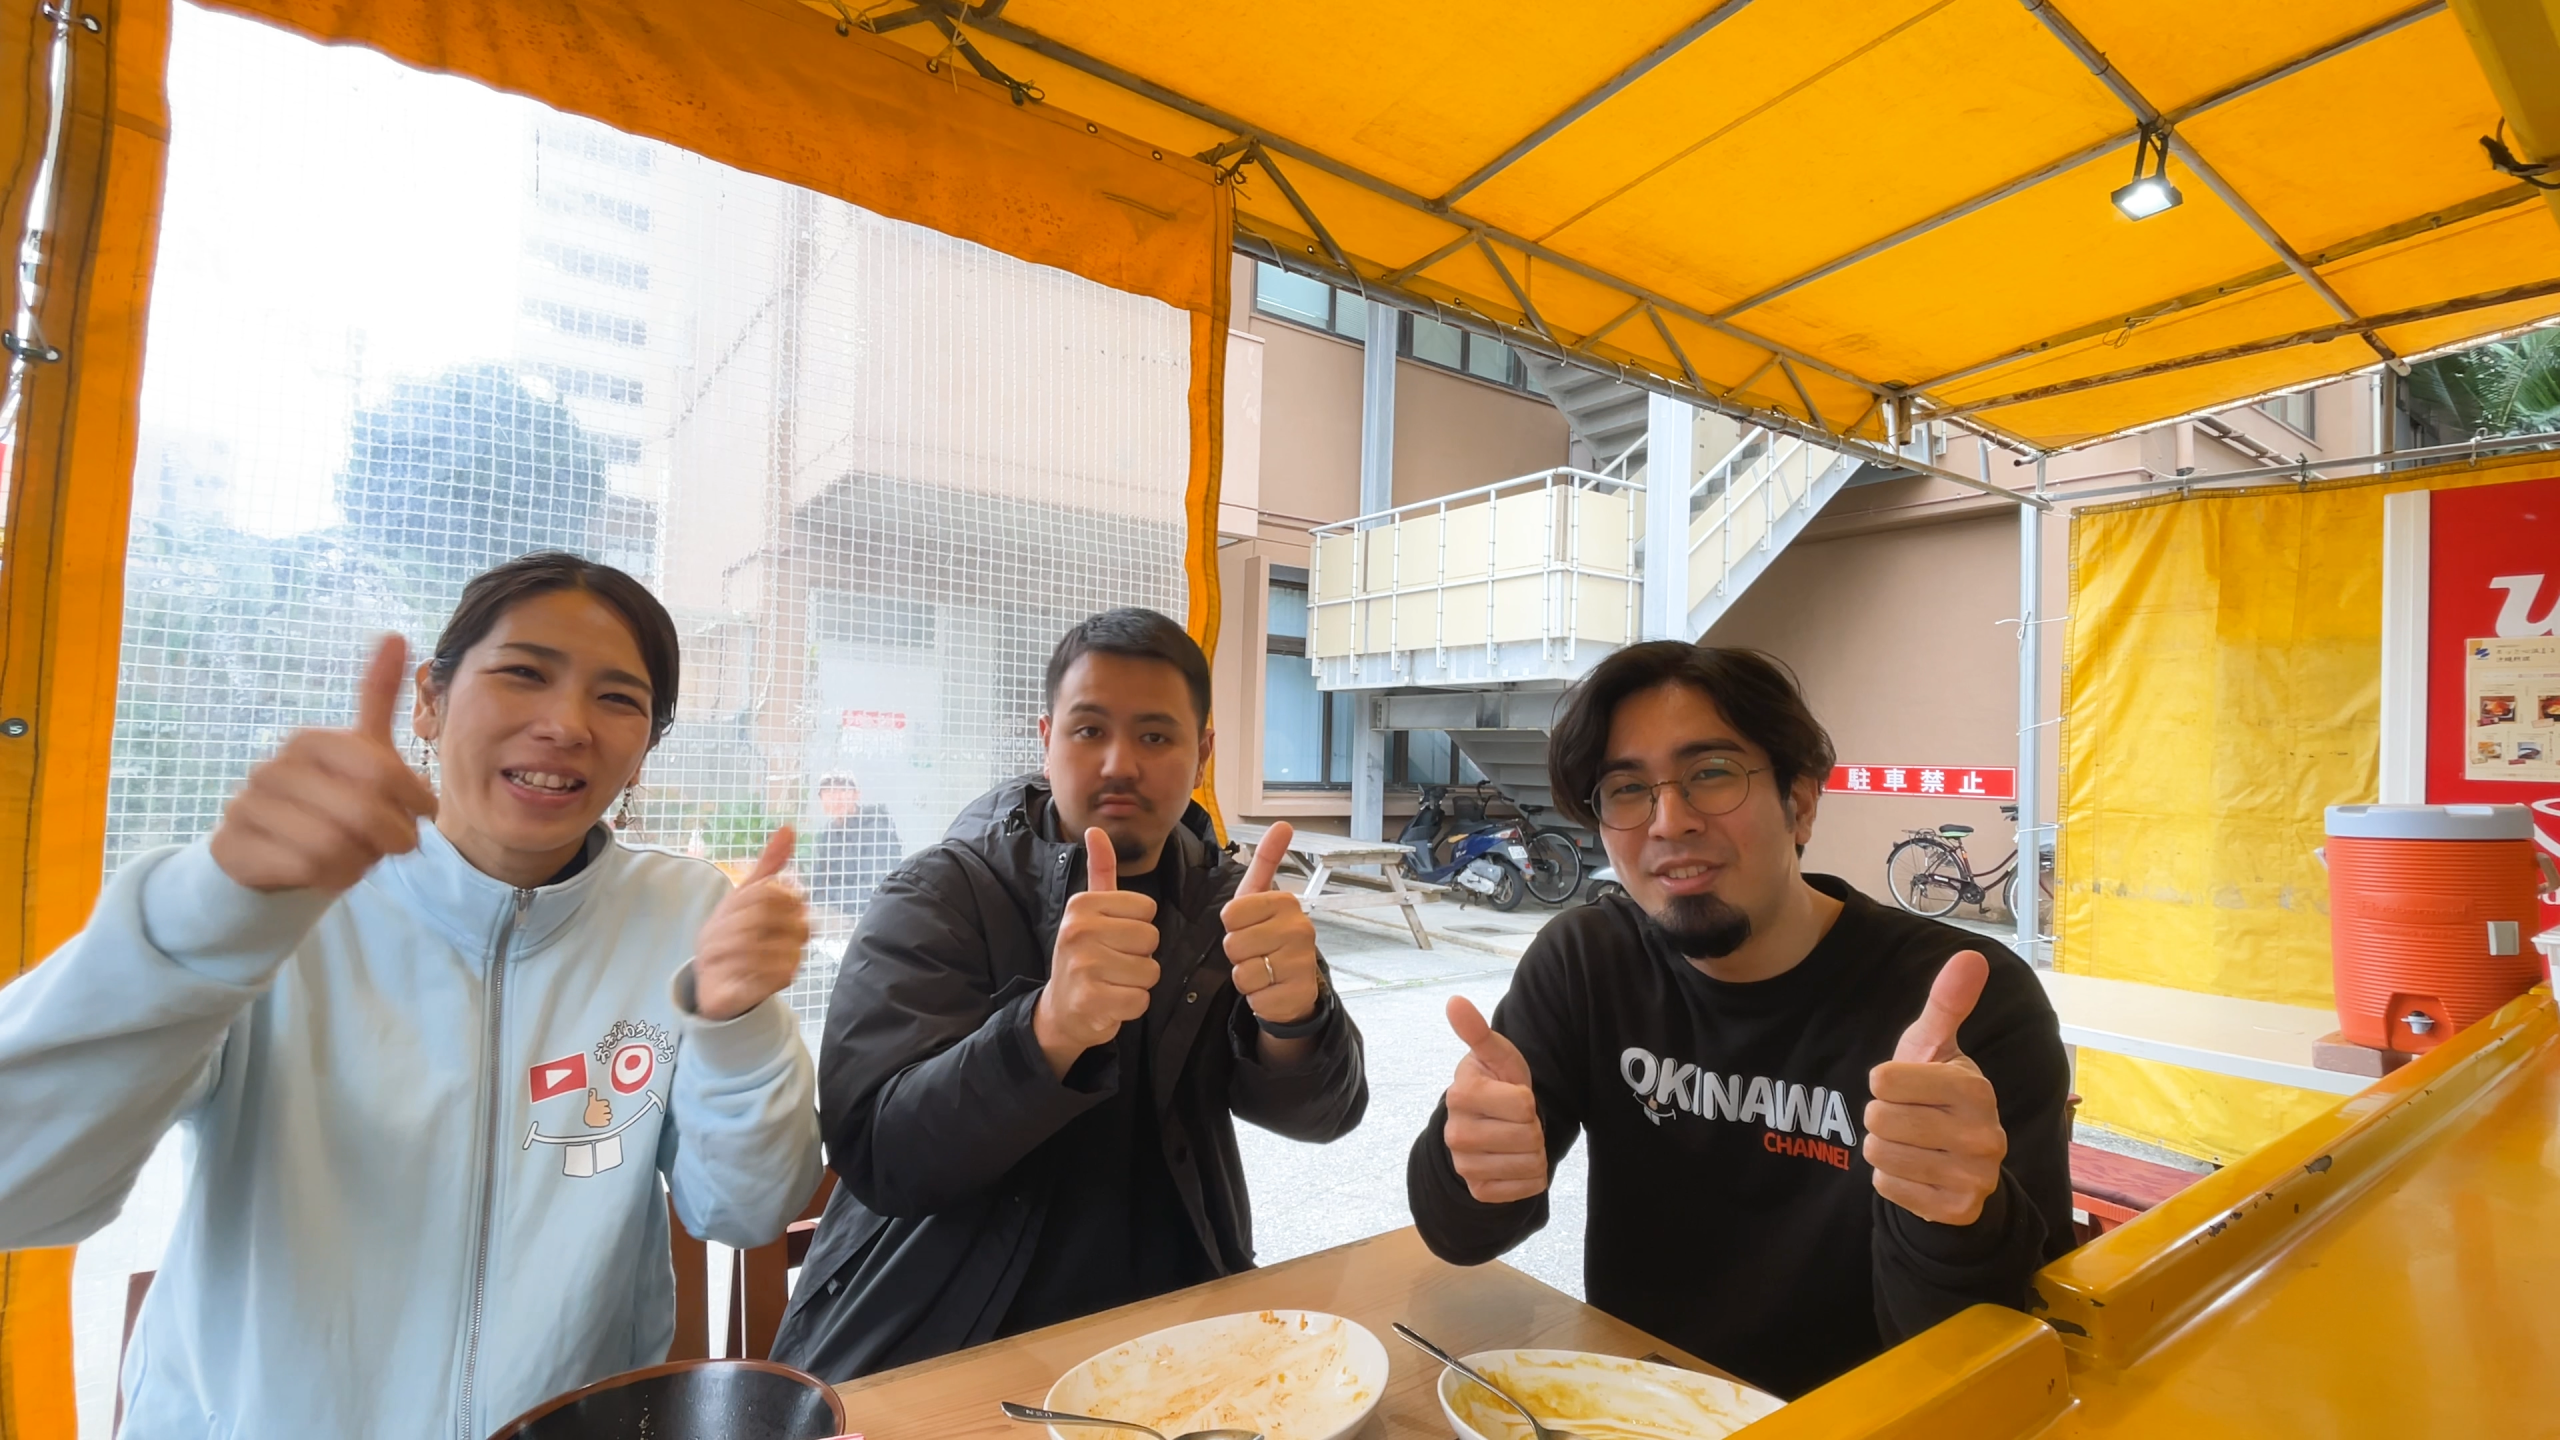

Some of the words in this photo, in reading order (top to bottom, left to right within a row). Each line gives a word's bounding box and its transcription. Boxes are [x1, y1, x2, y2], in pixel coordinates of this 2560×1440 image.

[1847, 767, 1986, 795] 駐車禁止
[593, 1019, 675, 1064] おきなわちゃんねる
[1619, 1046, 1857, 1147] OKINAWA
[1763, 1132, 1850, 1170] CHANNEL
